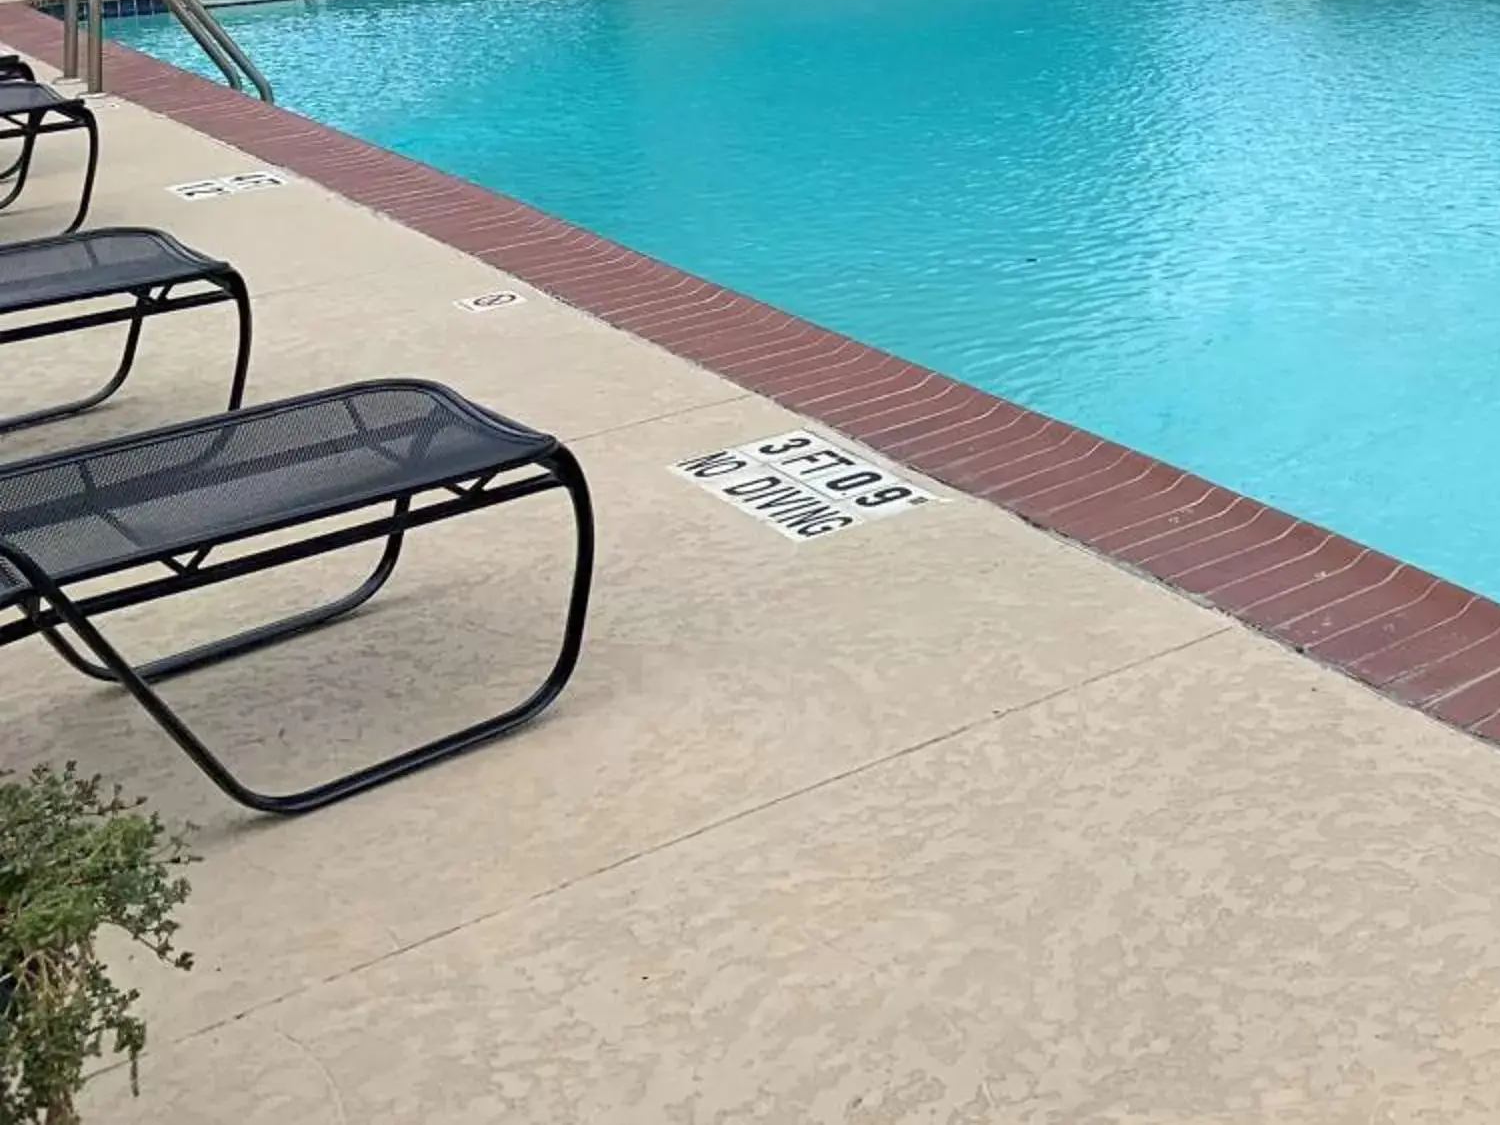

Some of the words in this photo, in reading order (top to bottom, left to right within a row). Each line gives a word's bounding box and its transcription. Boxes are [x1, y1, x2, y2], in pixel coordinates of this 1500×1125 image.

[759, 437, 811, 455] 3
[781, 450, 856, 476] FT
[676, 451, 747, 478] NO
[722, 476, 853, 537] DIVING
